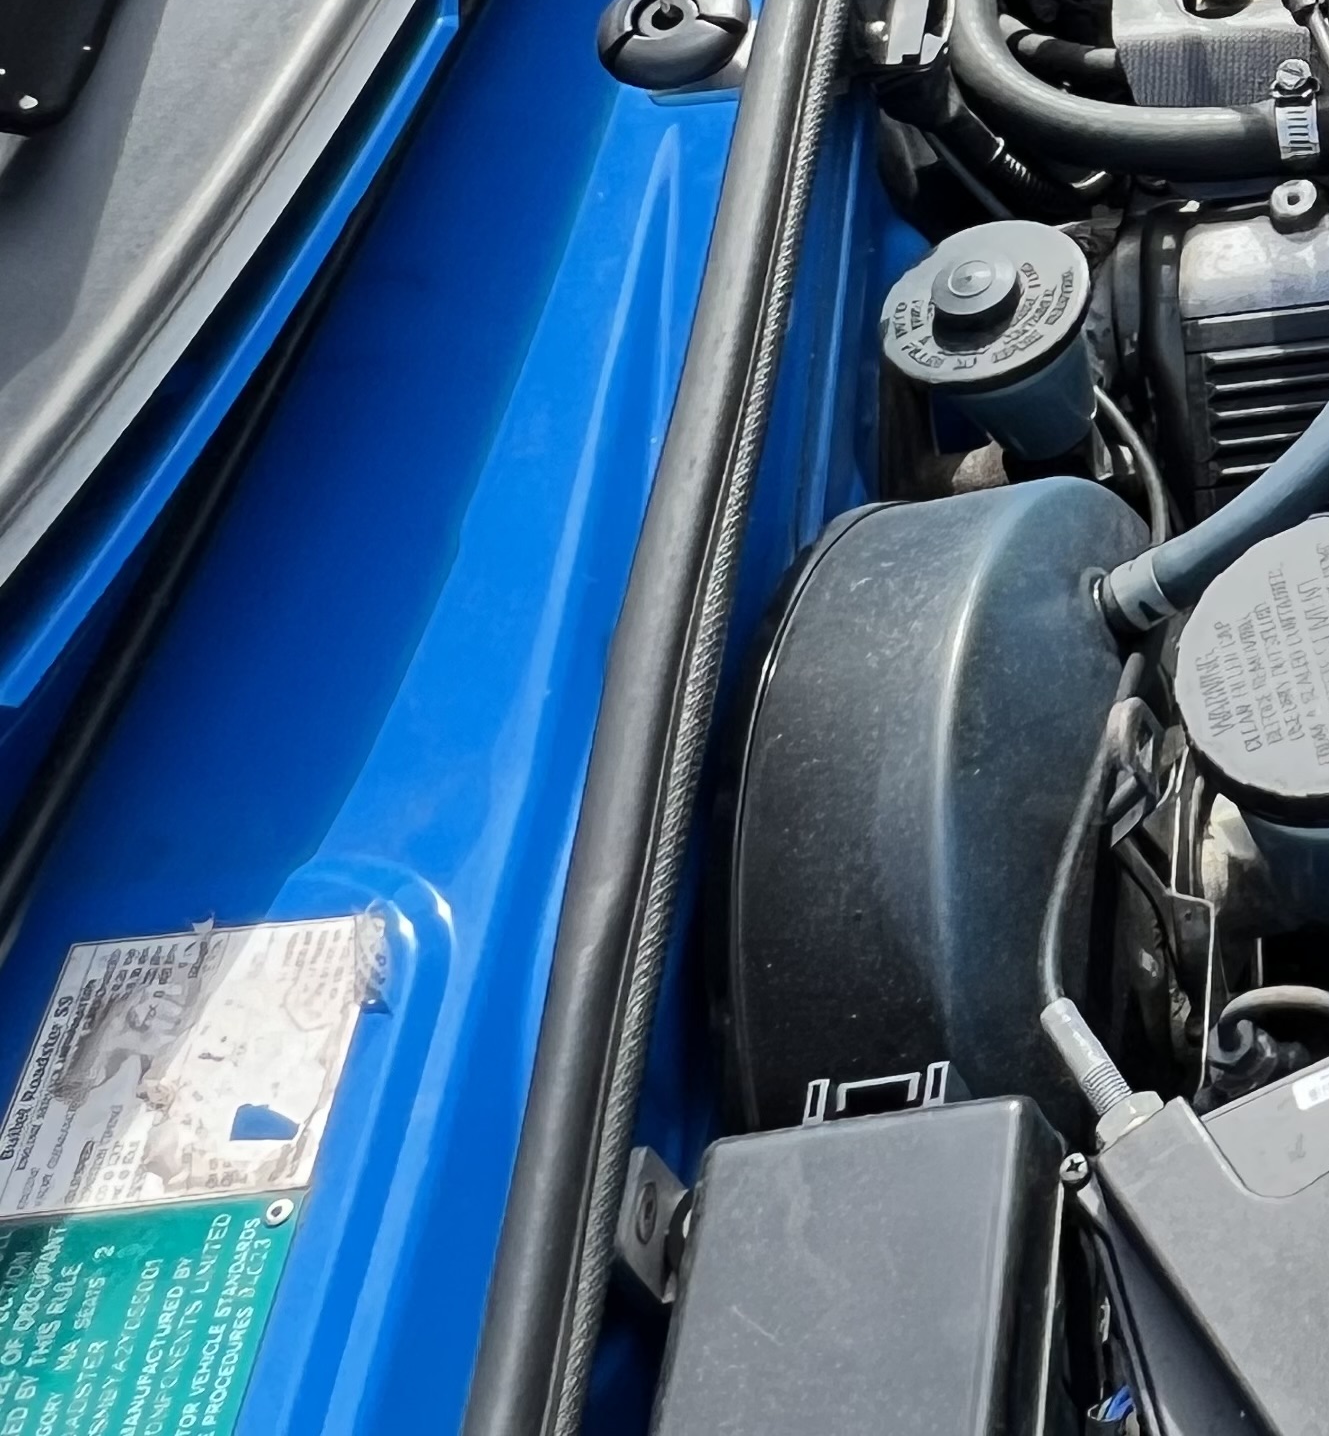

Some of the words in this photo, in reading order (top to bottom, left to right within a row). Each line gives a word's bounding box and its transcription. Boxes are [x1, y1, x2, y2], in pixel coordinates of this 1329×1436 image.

[92, 1244, 115, 1262] 2
[172, 1257, 194, 1281] BY
[46, 1261, 84, 1315] RULE
[188, 1323, 228, 1397] VEHICLE
[214, 1217, 261, 1318] STANDARDS
[25, 1319, 62, 1368] THIS
[201, 1305, 254, 1427] PROCEDURES
[15, 1375, 40, 1401] BY
